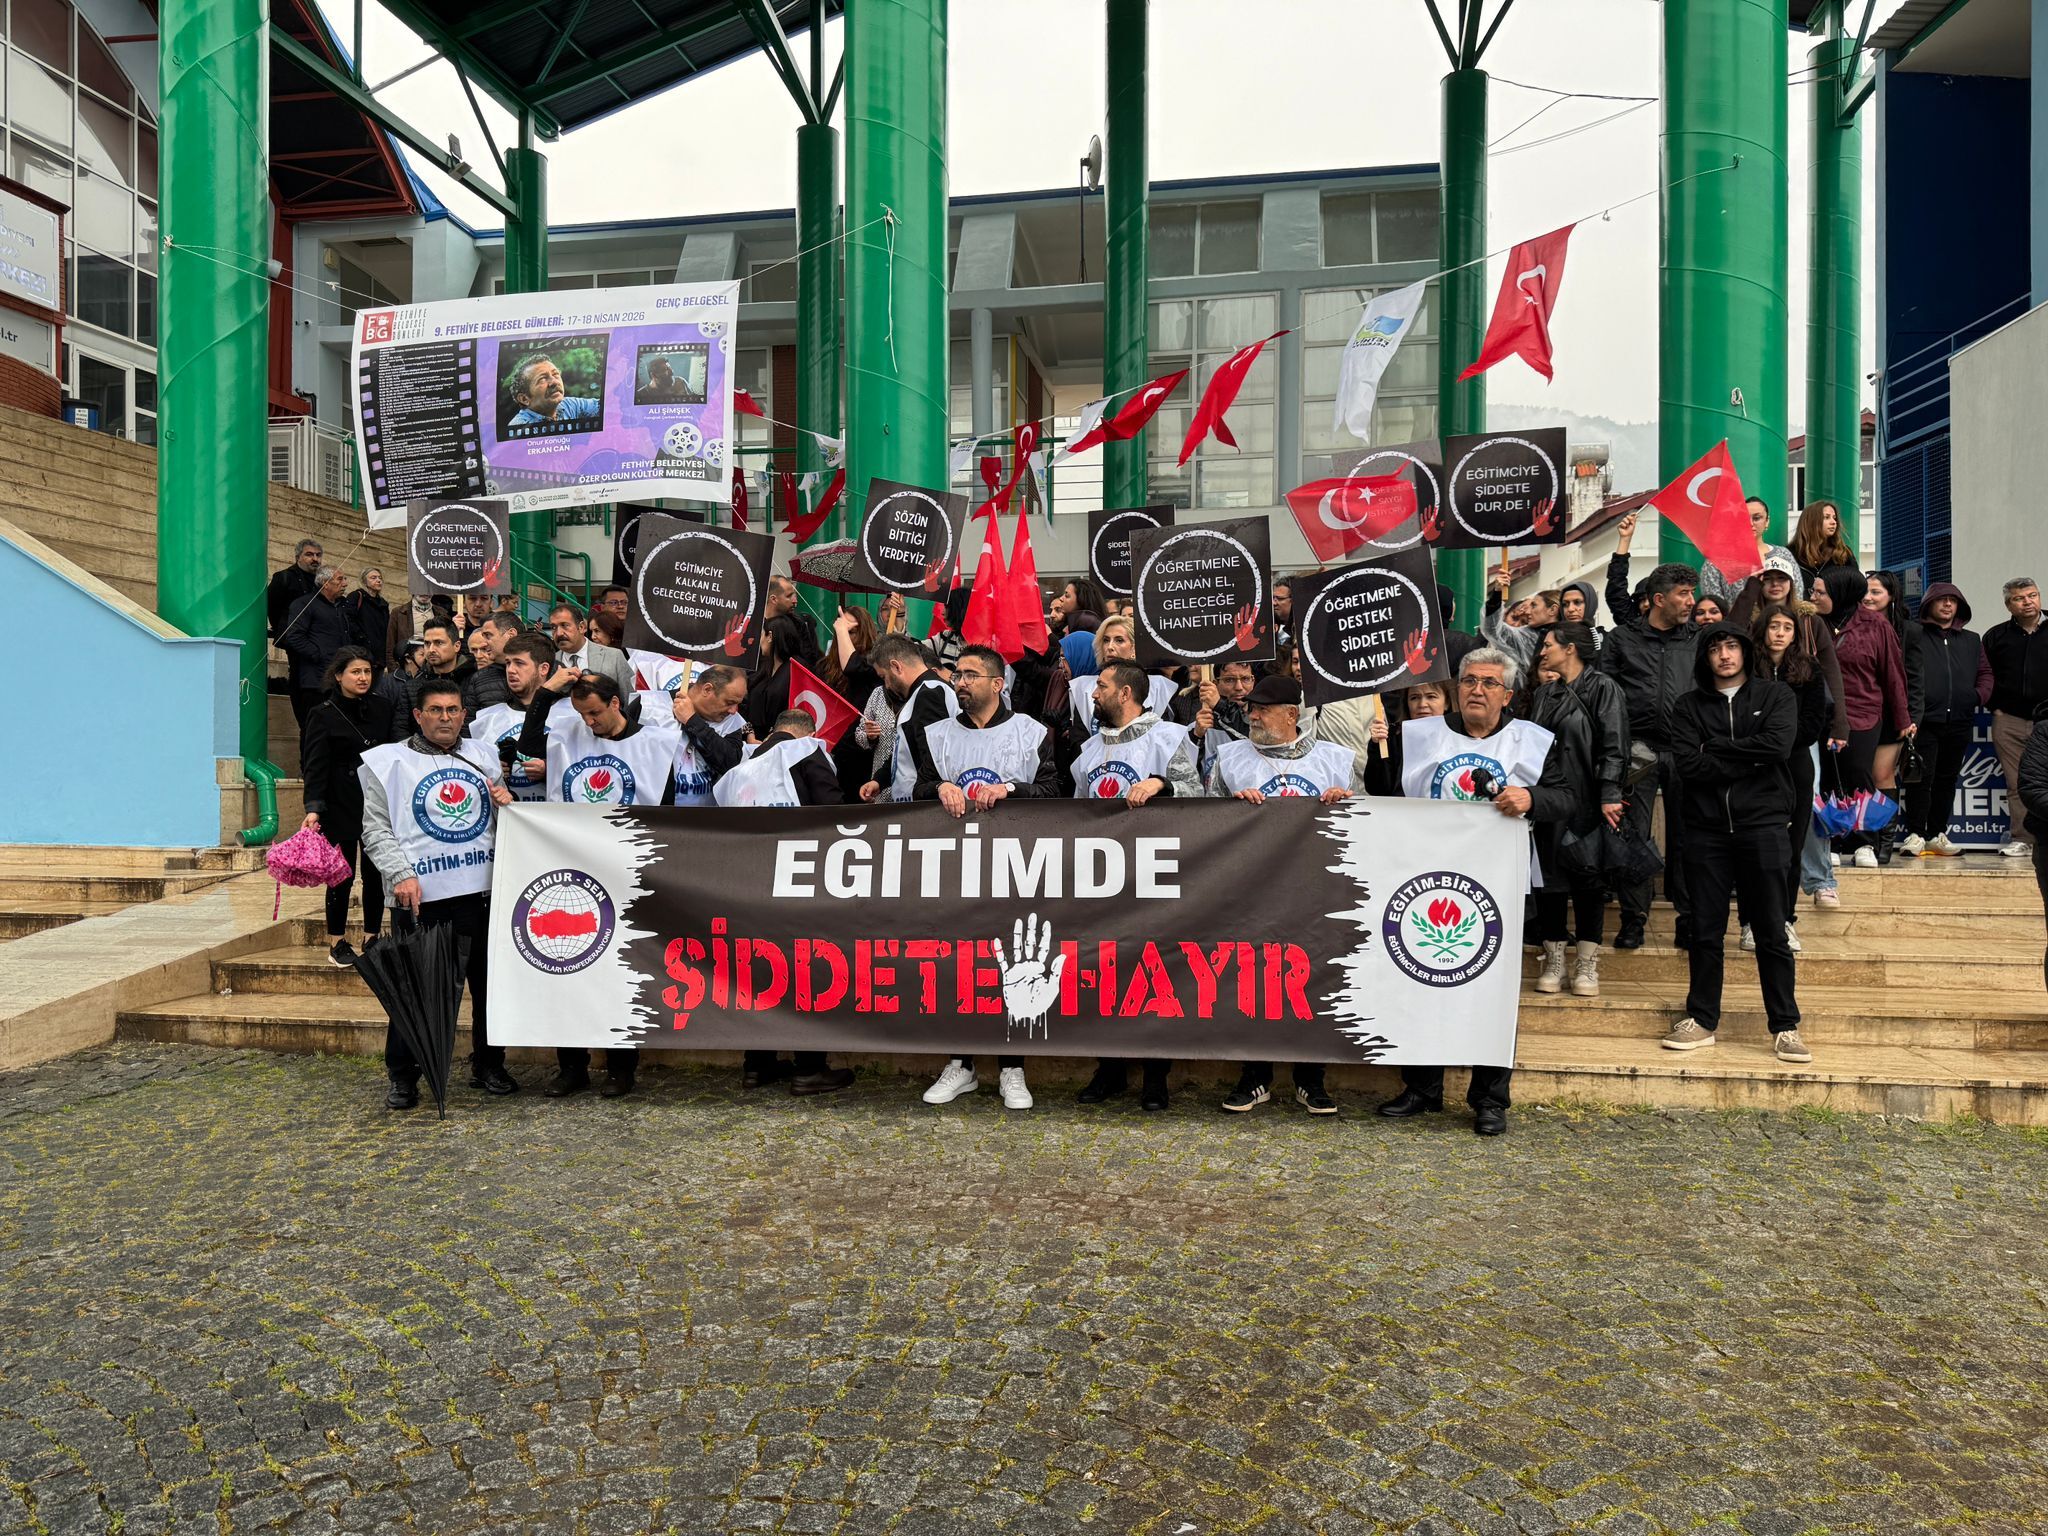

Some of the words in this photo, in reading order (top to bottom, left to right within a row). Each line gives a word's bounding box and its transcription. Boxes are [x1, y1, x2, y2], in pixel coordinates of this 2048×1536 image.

[656, 297, 681, 309] GENÇ
[683, 295, 729, 307] BELGESEL
[434, 327, 442, 337] 9.
[445, 322, 479, 336] FETHİYE
[481, 319, 522, 332] BELGESEL
[525, 315, 564, 328] GÜNLERİ:
[567, 314, 592, 325] 17-18
[594, 311, 620, 323] NİSAN
[622, 311, 645, 322] 2026
[0, 327, 18, 343] l.tr
[662, 407, 691, 415] ŞİMŞEK
[527, 439, 543, 447] Onur
[545, 437, 570, 445] Konuğu
[527, 446, 552, 455] ERKAN
[553, 444, 570, 452] CAN
[621, 460, 655, 469] FETHİYE
[656, 459, 706, 469] BELEDİYESİ
[1466, 464, 1540, 480] EĞİTİMCİYE
[579, 474, 600, 484] ÖZER
[601, 471, 630, 481] OLGUN
[631, 468, 664, 479] KÜLTÜR
[665, 469, 705, 479] MERKEZİ
[1475, 482, 1531, 499] ŞİDDETE
[1474, 501, 1502, 513] DUR
[1505, 500, 1523, 510] DE
[1527, 499, 1530, 509] !
[425, 523, 488, 532] ÖĞRETMENE
[894, 510, 929, 528] SÖZÜN
[427, 536, 467, 544] UZANAN
[469, 536, 484, 546] EL,
[888, 527, 927, 547] BİTTİĞİ
[430, 547, 484, 557] GELECEĞE
[879, 545, 932, 568] YERDEYİZ...
[427, 559, 482, 570] İHANETTİR
[674, 561, 724, 579] EĞİTİMCİYE
[1155, 555, 1240, 575] ÖĞRETMENE
[1771, 560, 1780, 568] LA
[675, 576, 709, 590] KALKAN
[711, 583, 721, 593] EL
[1158, 577, 1214, 593] UZANAN
[1215, 576, 1235, 589] EL,
[652, 586, 697, 603] GELECEĞE
[700, 594, 738, 610] VURULAN
[1162, 593, 1236, 611] GELECEĞE
[1324, 583, 1402, 613] ÖĞRETMENE
[673, 604, 713, 620] DARBEDİR
[1159, 612, 1233, 630] İHANETTİR
[1338, 606, 1393, 632] DESTEK!
[1341, 628, 1396, 653] ŞİDDETE
[1349, 651, 1394, 673] HAYIR!
[771, 823, 1181, 899] EĞİTİMDE
[524, 872, 572, 902] MEMUR
[583, 879, 607, 902] SEN
[1388, 875, 1497, 923] EĞİTİM-BİR-SEN
[513, 926, 526, 951] MEMUR
[523, 948, 562, 973] SENDİKALARI
[563, 928, 612, 973] KONFEDERASYONU
[1388, 935, 1431, 981] EĞİTİMCİLER
[1431, 972, 1466, 983] BİRLİĞİ
[1465, 935, 1498, 976] SENDİKASI
[661, 917, 1002, 1030] ŞİDDETE
[1060, 940, 1315, 1021] HAYIR
